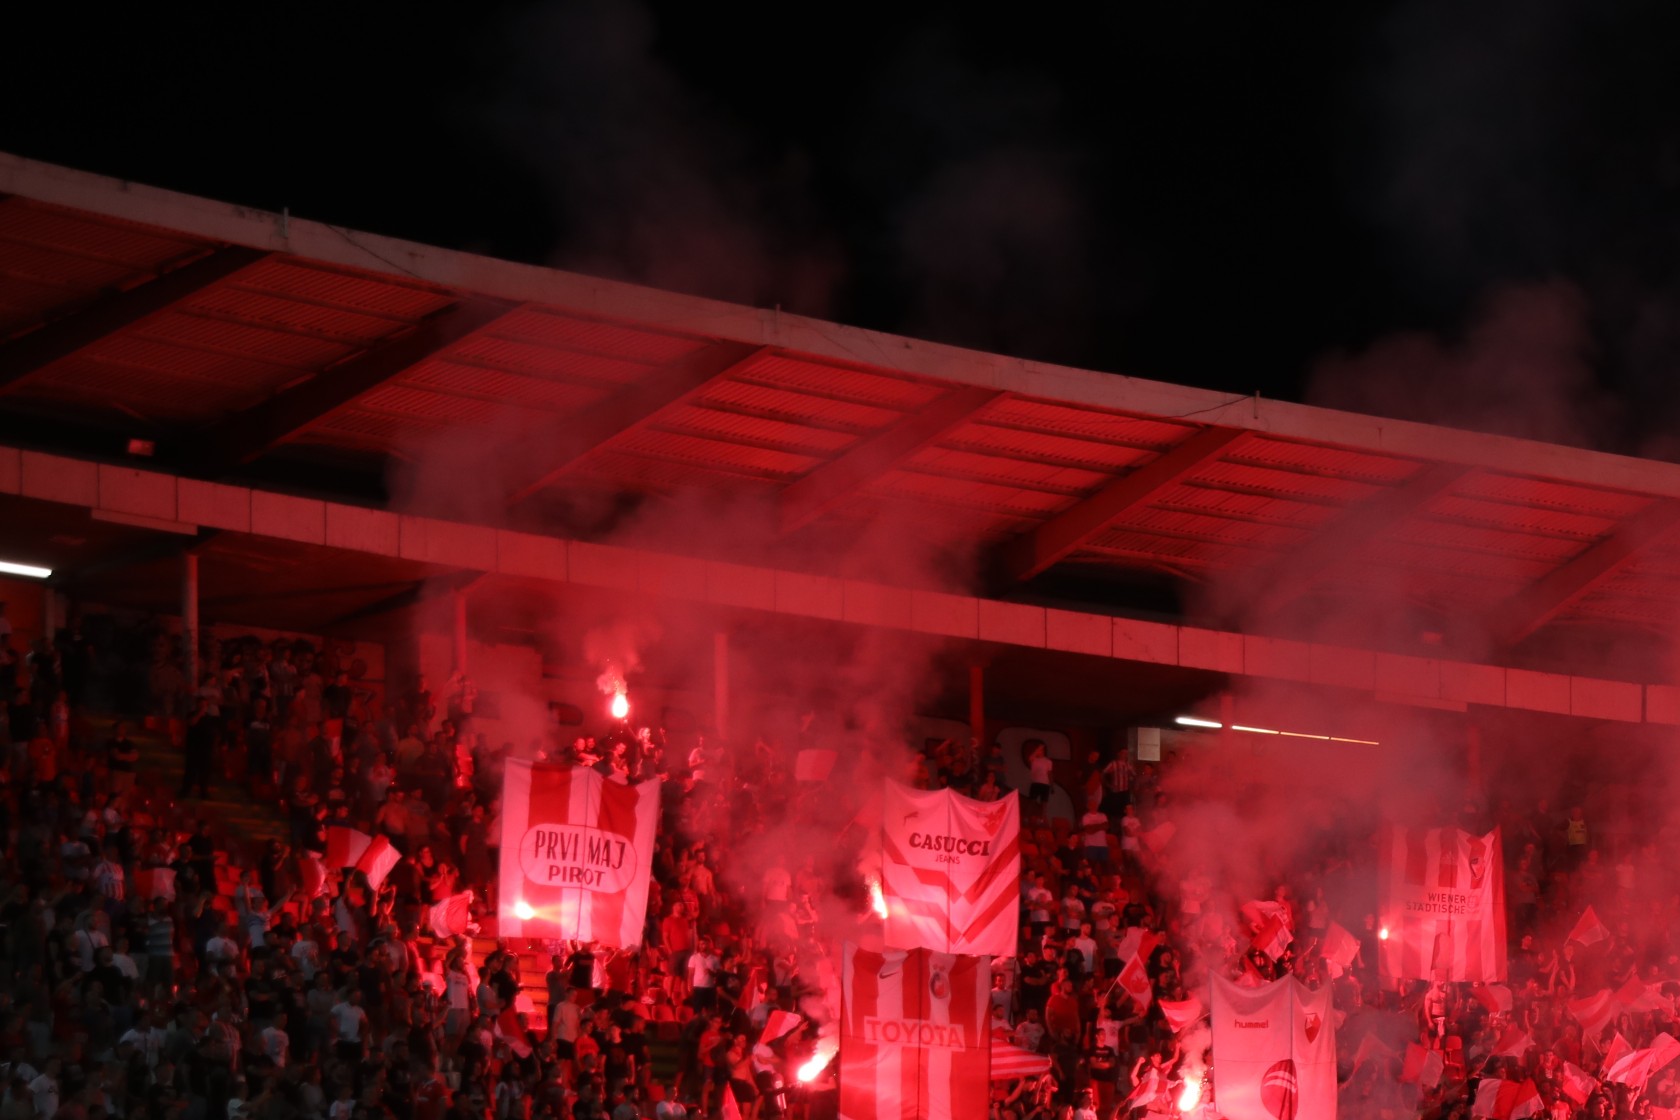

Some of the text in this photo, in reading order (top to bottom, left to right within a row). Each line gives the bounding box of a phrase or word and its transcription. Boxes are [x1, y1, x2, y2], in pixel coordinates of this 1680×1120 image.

[534, 830, 626, 870] PRVI MAJ
[909, 832, 991, 857] CASUCCI
[935, 854, 961, 865] JEANS
[548, 864, 606, 887] PIROT
[1428, 892, 1467, 904] WIENER
[866, 1020, 963, 1048] TOYOTA
[1234, 1018, 1269, 1029] hummel
